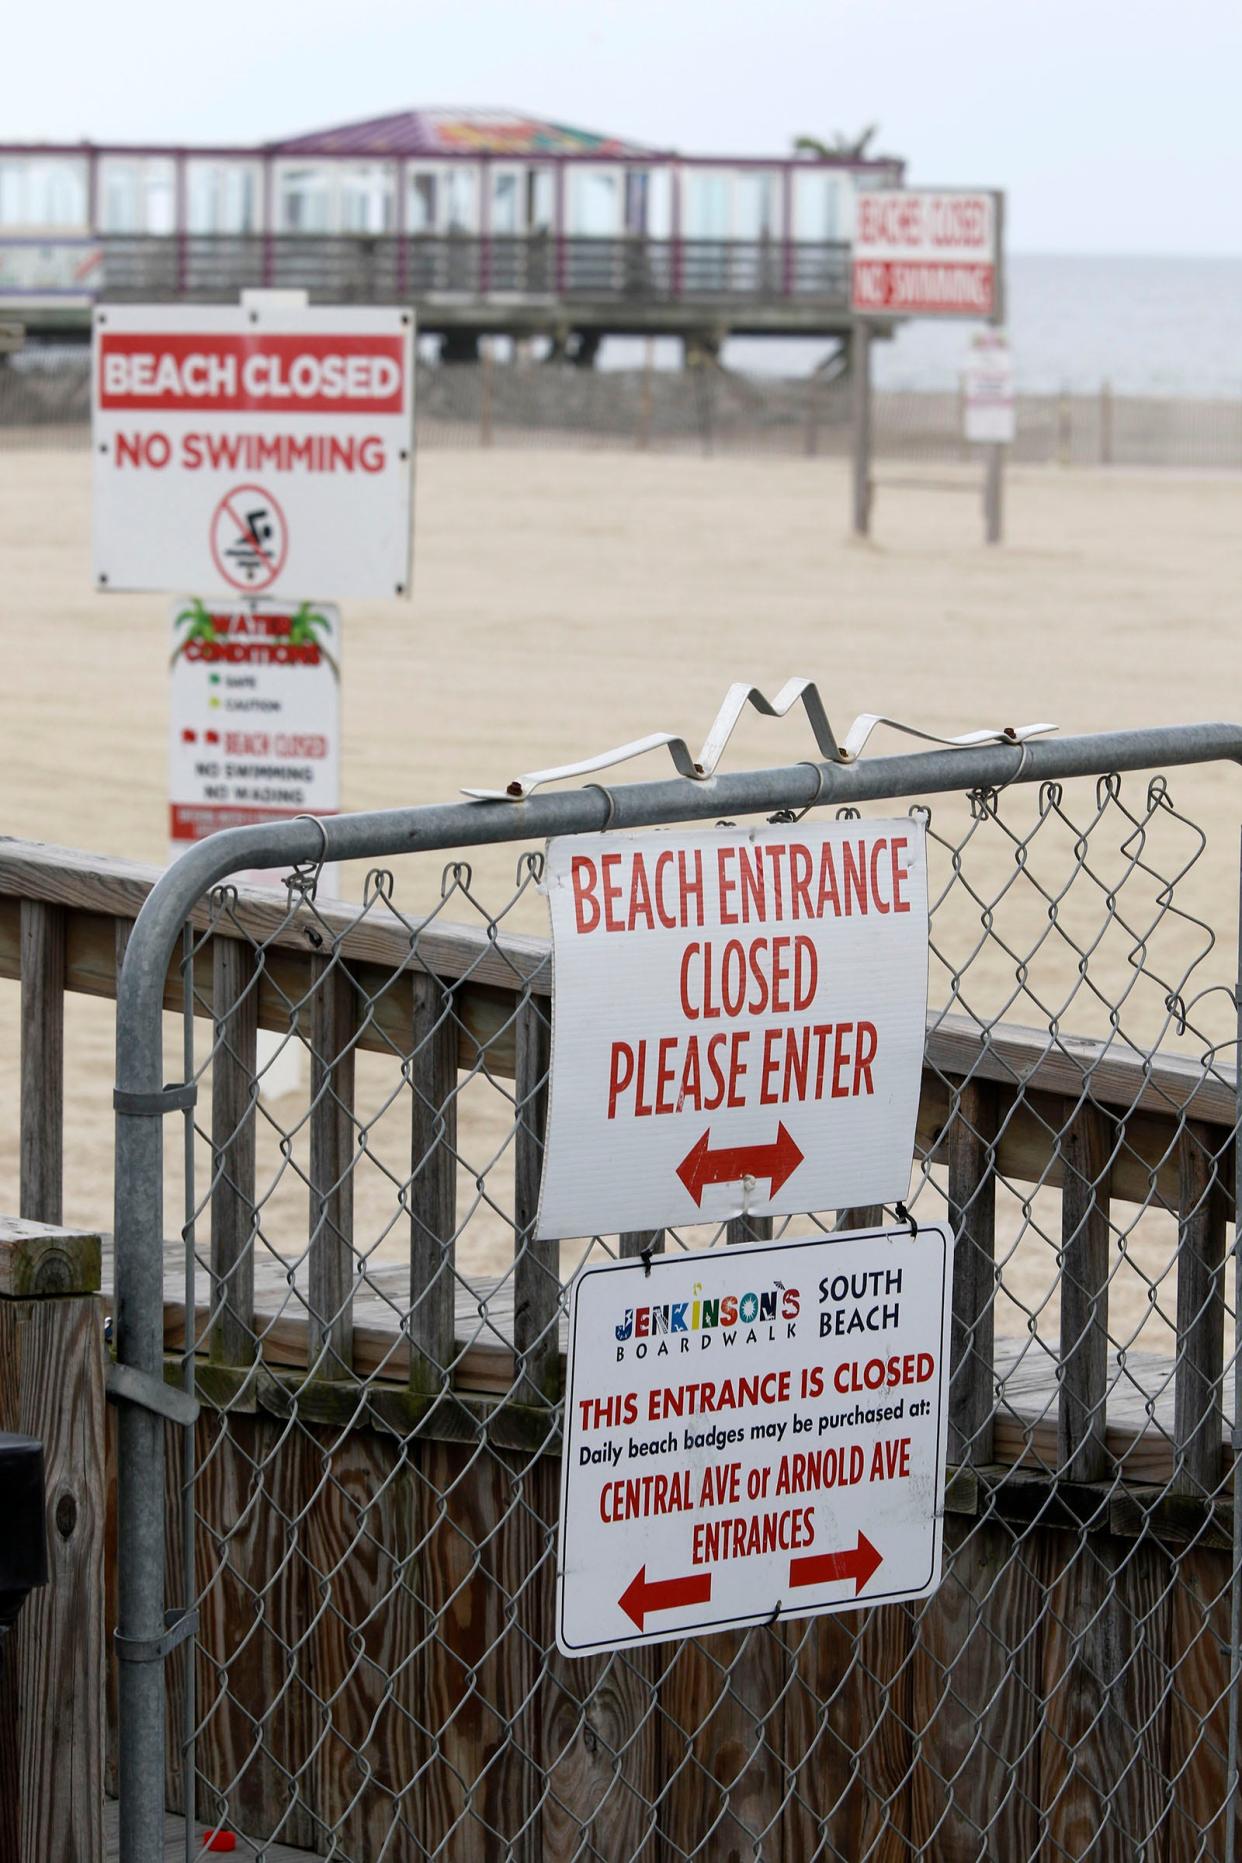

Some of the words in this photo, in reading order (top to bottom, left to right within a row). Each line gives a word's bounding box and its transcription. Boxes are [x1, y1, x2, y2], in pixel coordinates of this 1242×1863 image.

[858, 264, 885, 302] NO
[895, 265, 990, 306] SWIMMING
[104, 354, 237, 396] BEACH
[243, 354, 400, 398] CLOSED
[115, 432, 171, 469] NO
[182, 432, 385, 473] SWIMMING
[210, 614, 293, 638] WATER
[183, 640, 321, 666] CONDITIONS
[225, 675, 256, 689] SAFE
[225, 699, 281, 712] CAUTION
[225, 732, 269, 755] BEACH
[276, 734, 327, 759] CLOSED
[196, 763, 218, 777] NO
[225, 764, 314, 782] SWIMMING
[205, 785, 227, 800] NO
[235, 786, 304, 804] WADING
[571, 849, 704, 934] BEACH
[717, 837, 911, 925] ENTRANCE
[680, 934, 818, 1020] CLOSED
[607, 1031, 751, 1120] PLEASE
[760, 1021, 878, 1106] ENTER
[818, 1268, 903, 1303] SOUTH
[819, 1303, 900, 1338] BEACH
[616, 1322, 796, 1362] BOARDWALK
[579, 1392, 638, 1431] THIS
[648, 1371, 791, 1421] ENTRANCE
[801, 1366, 824, 1399] IS
[833, 1352, 935, 1394] CLOSED
[579, 1441, 622, 1467] Daily
[628, 1427, 677, 1458] beach
[684, 1421, 744, 1451] badges
[751, 1419, 787, 1441] may
[793, 1414, 813, 1434] be
[818, 1399, 903, 1439] purchased
[909, 1399, 931, 1417] at:
[599, 1470, 693, 1523] CENTRAL
[700, 1462, 742, 1507] AVE
[747, 1467, 772, 1500] or
[776, 1447, 864, 1496] ARNOLD
[870, 1438, 911, 1482] AVE
[692, 1507, 815, 1564] ENTRANCES
